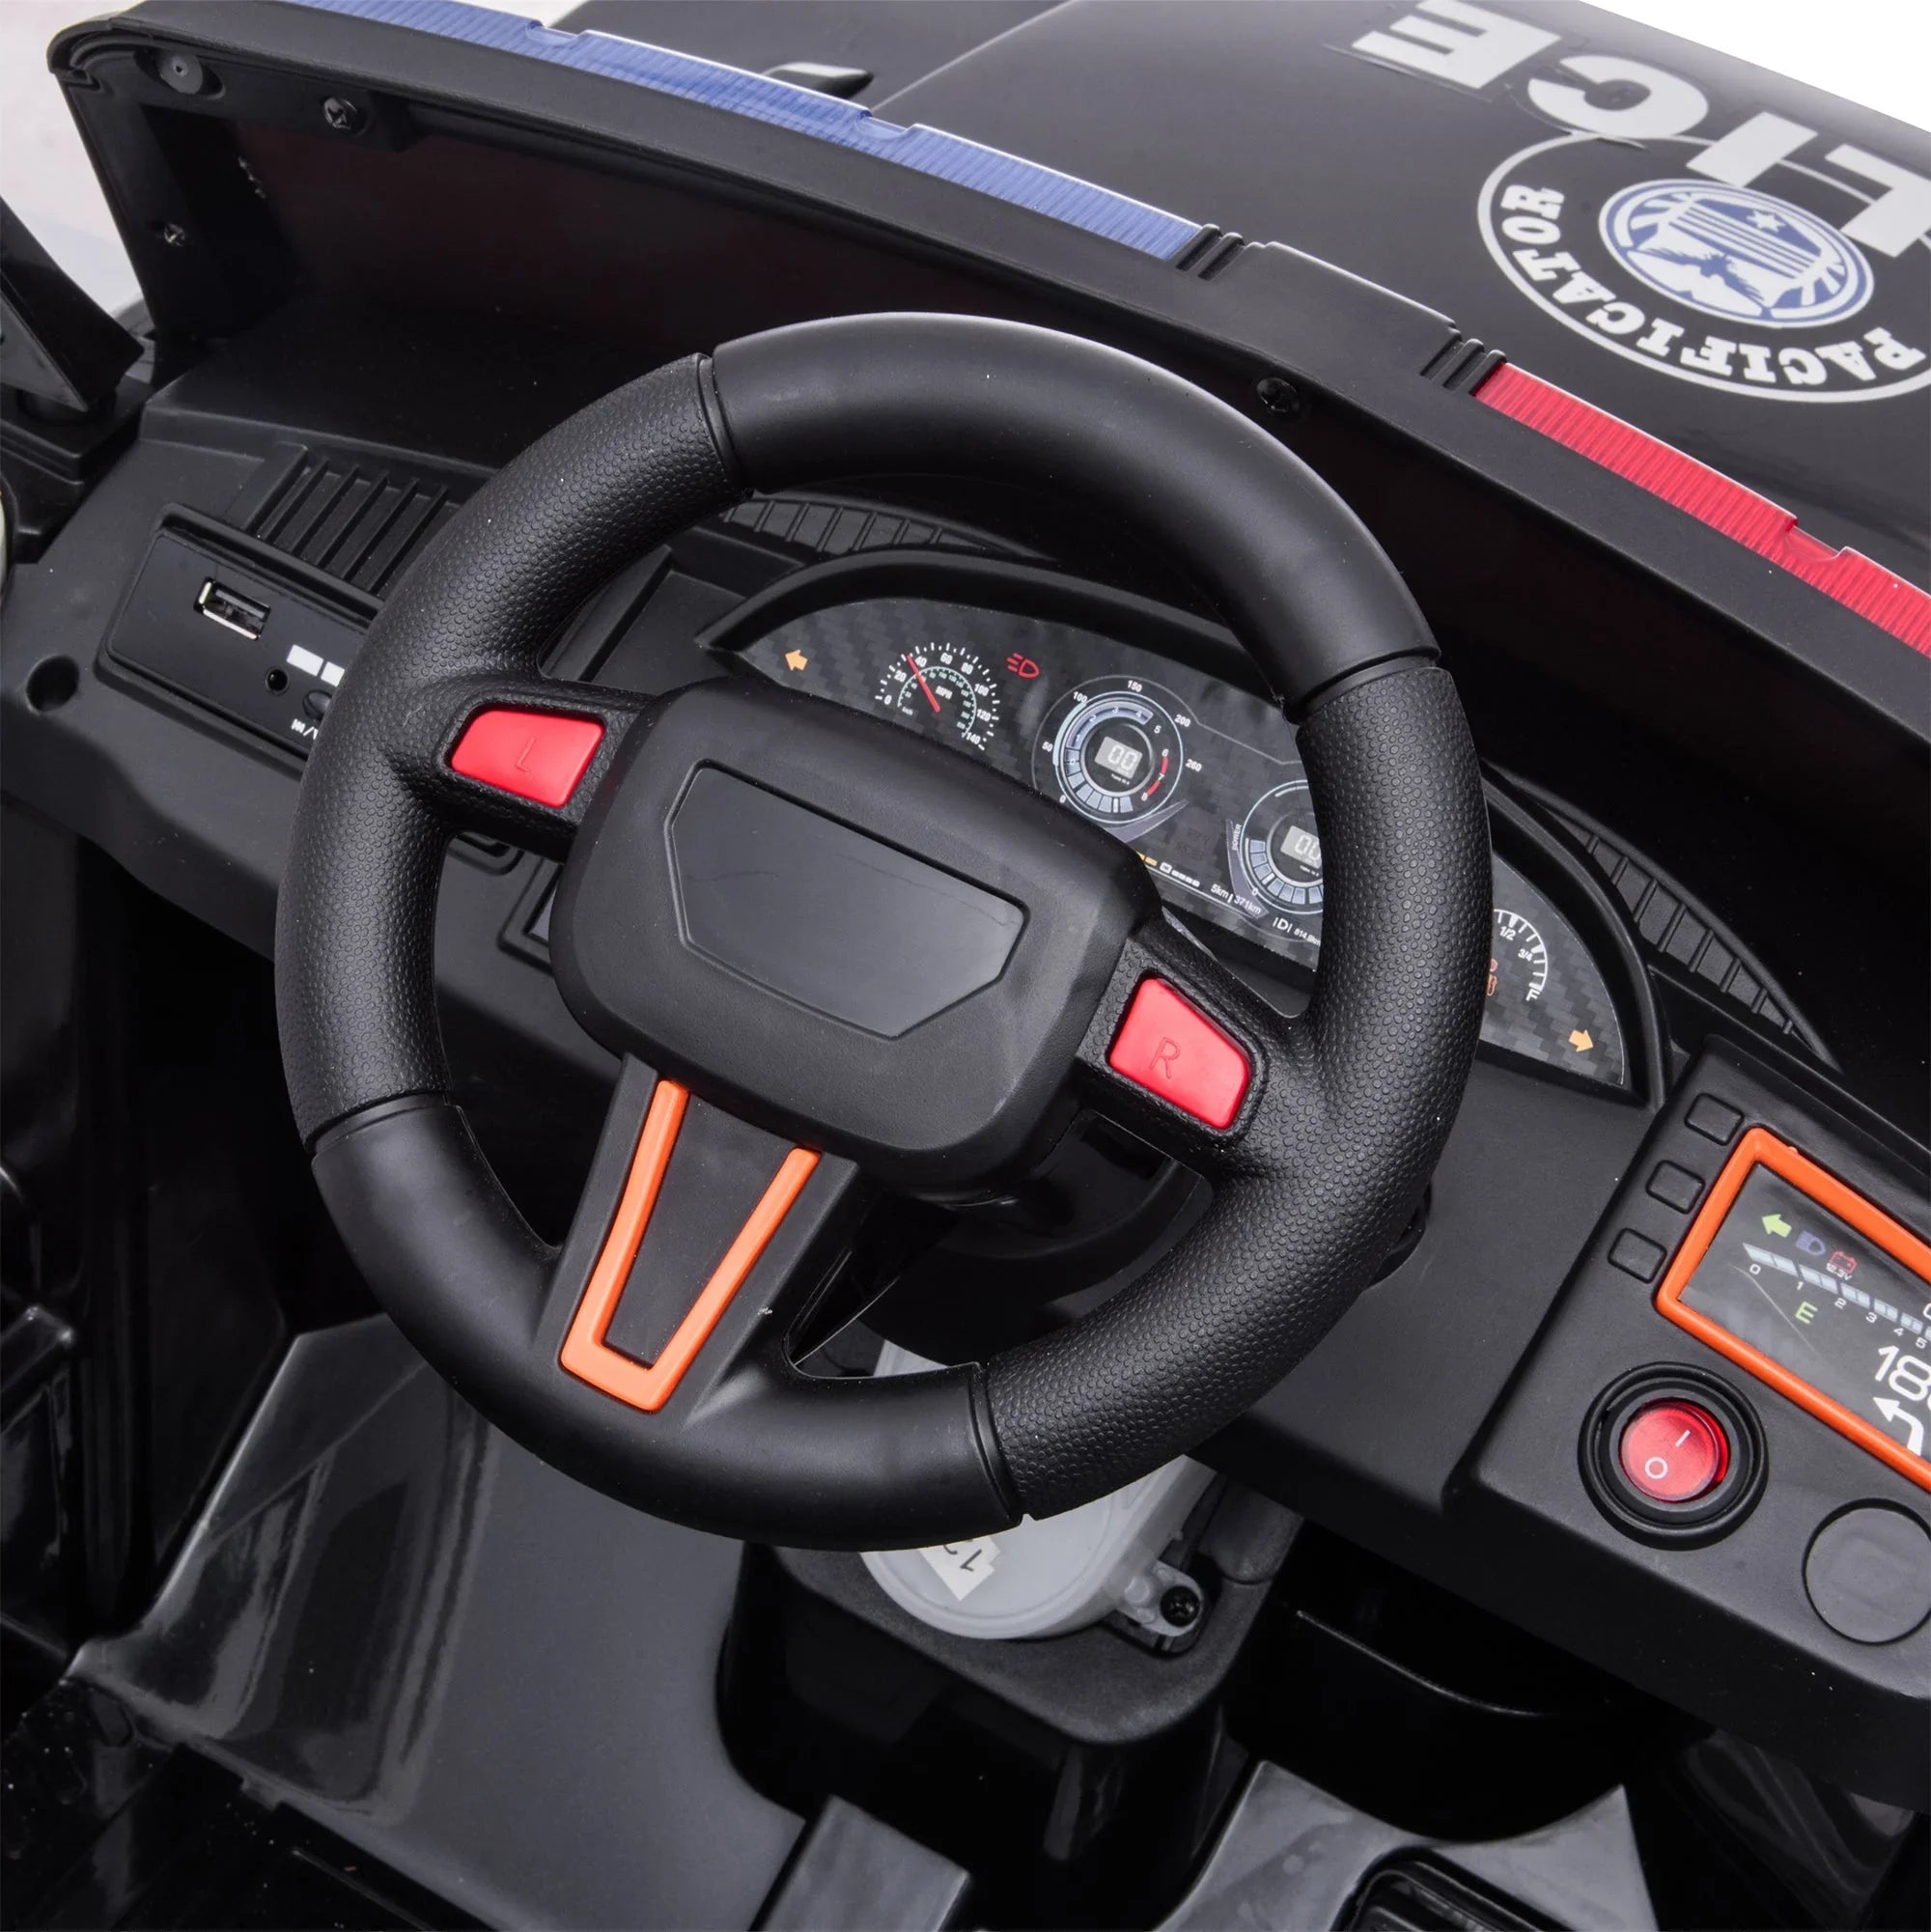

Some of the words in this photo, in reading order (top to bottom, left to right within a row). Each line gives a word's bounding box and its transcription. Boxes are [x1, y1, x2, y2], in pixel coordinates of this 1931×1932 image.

[1500, 184, 1926, 385] PACIFICATOR
[939, 652, 953, 665] 60
[894, 669, 908, 683] 20
[974, 683, 990, 697] 100
[1127, 679, 1143, 693] 150
[883, 694, 892, 706] 0
[1073, 690, 1088, 704] 100
[976, 708, 992, 722] 120
[1111, 705, 1119, 714] 3
[1089, 714, 1097, 723] 2
[1174, 714, 1191, 728] 200
[1153, 724, 1161, 735] 5
[966, 731, 981, 745] 140
[1042, 741, 1054, 753] 50
[1161, 748, 1169, 758] 6
[1185, 758, 1203, 773] 260
[1059, 795, 1067, 804] 0
[1210, 882, 1231, 901] 5km
[1233, 894, 1263, 915] 371km
[1251, 887, 1259, 897] 0
[1499, 926, 1516, 941] 1/2
[1518, 948, 1533, 962] 3/4
[1525, 989, 1540, 1001] F
[1149, 1036, 1182, 1079] R
[1749, 1263, 1762, 1275] 0
[1796, 1280, 1805, 1291] 1
[1833, 1297, 1848, 1310] 2
[1794, 1301, 1819, 1325] E
[1864, 1311, 1879, 1324] 3
[1892, 1327, 1905, 1337] 4
[1915, 1336, 1928, 1350] 5
[1874, 1344, 1931, 1402] 18
